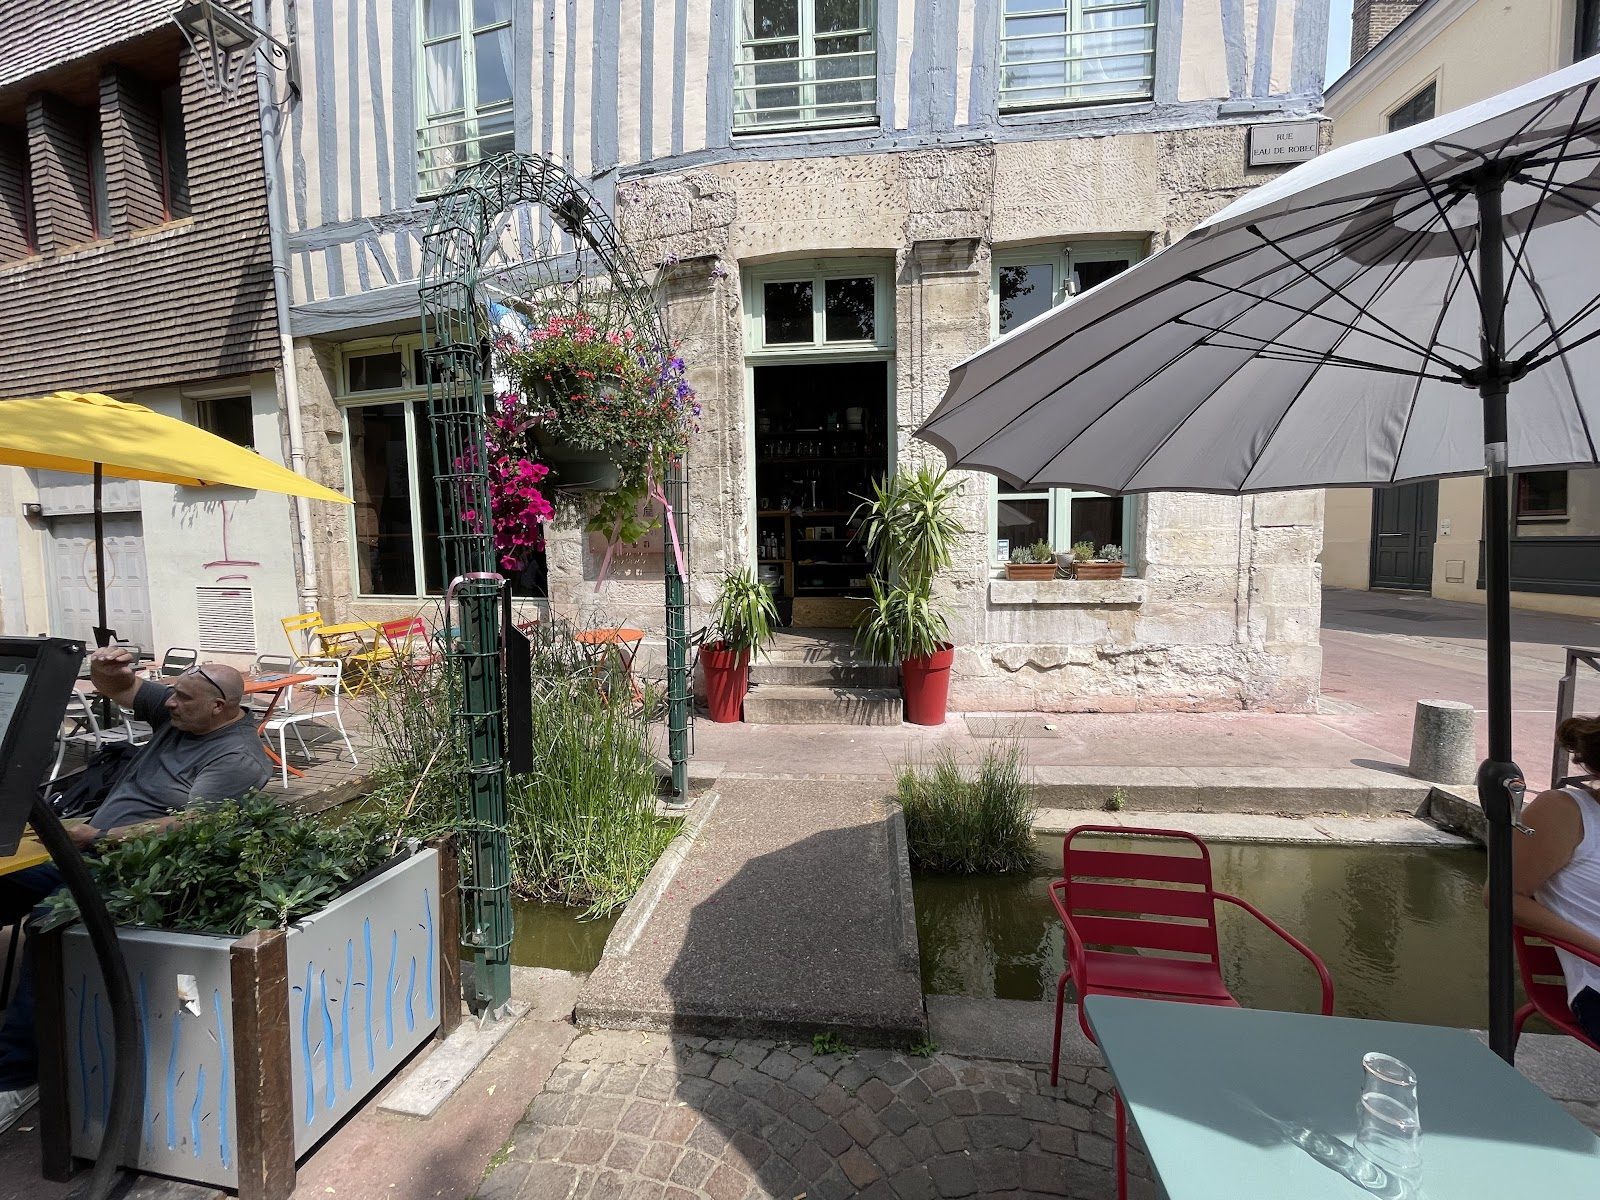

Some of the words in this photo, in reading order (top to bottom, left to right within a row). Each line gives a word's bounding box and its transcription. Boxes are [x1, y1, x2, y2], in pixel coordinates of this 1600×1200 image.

[1276, 132, 1294, 141] RUE
[1253, 148, 1271, 156] EAU
[1274, 146, 1285, 154] DE
[1288, 144, 1316, 153] ROBEC
